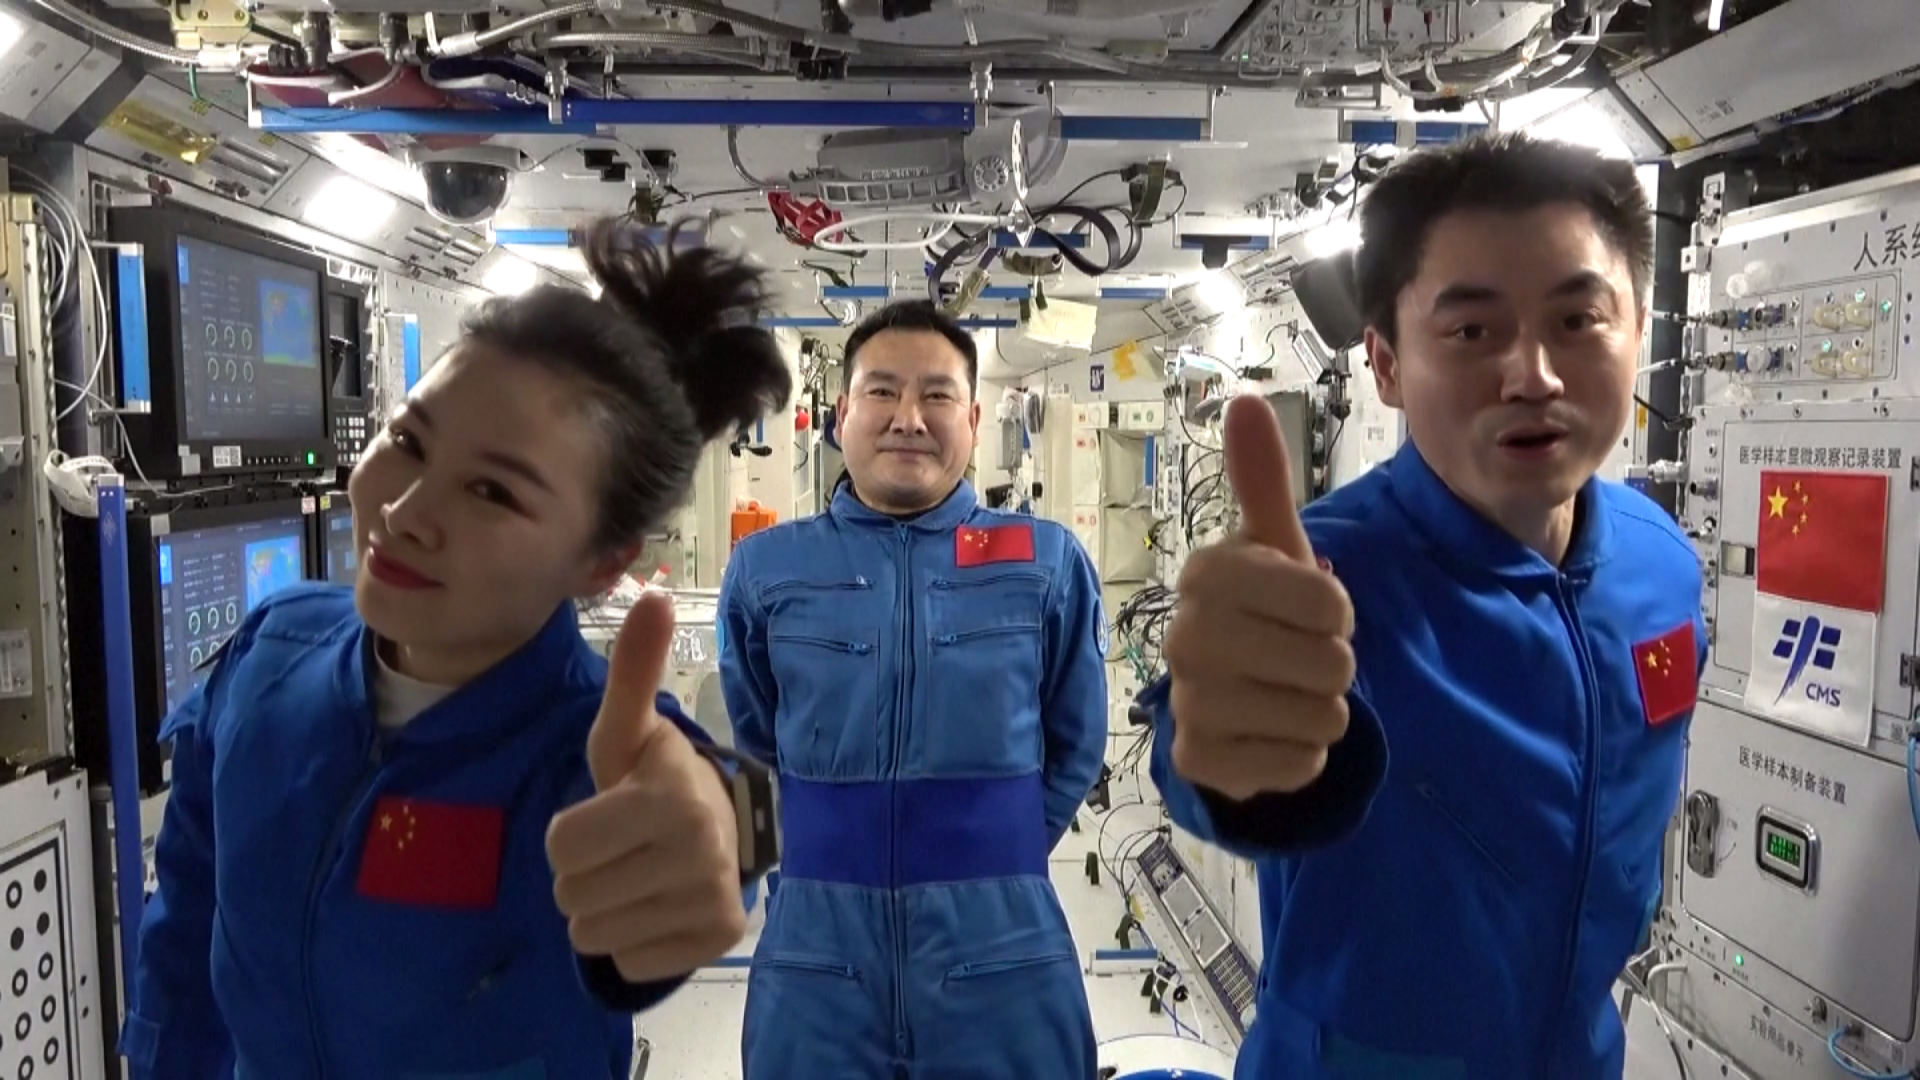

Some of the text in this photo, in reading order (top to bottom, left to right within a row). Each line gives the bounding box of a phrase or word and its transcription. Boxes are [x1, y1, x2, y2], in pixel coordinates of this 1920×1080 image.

[1740, 446, 1902, 469] 医学样本显微观察记录装置
[1806, 683, 1841, 708] CMS
[1739, 745, 1846, 805] 医学样本制备装置
